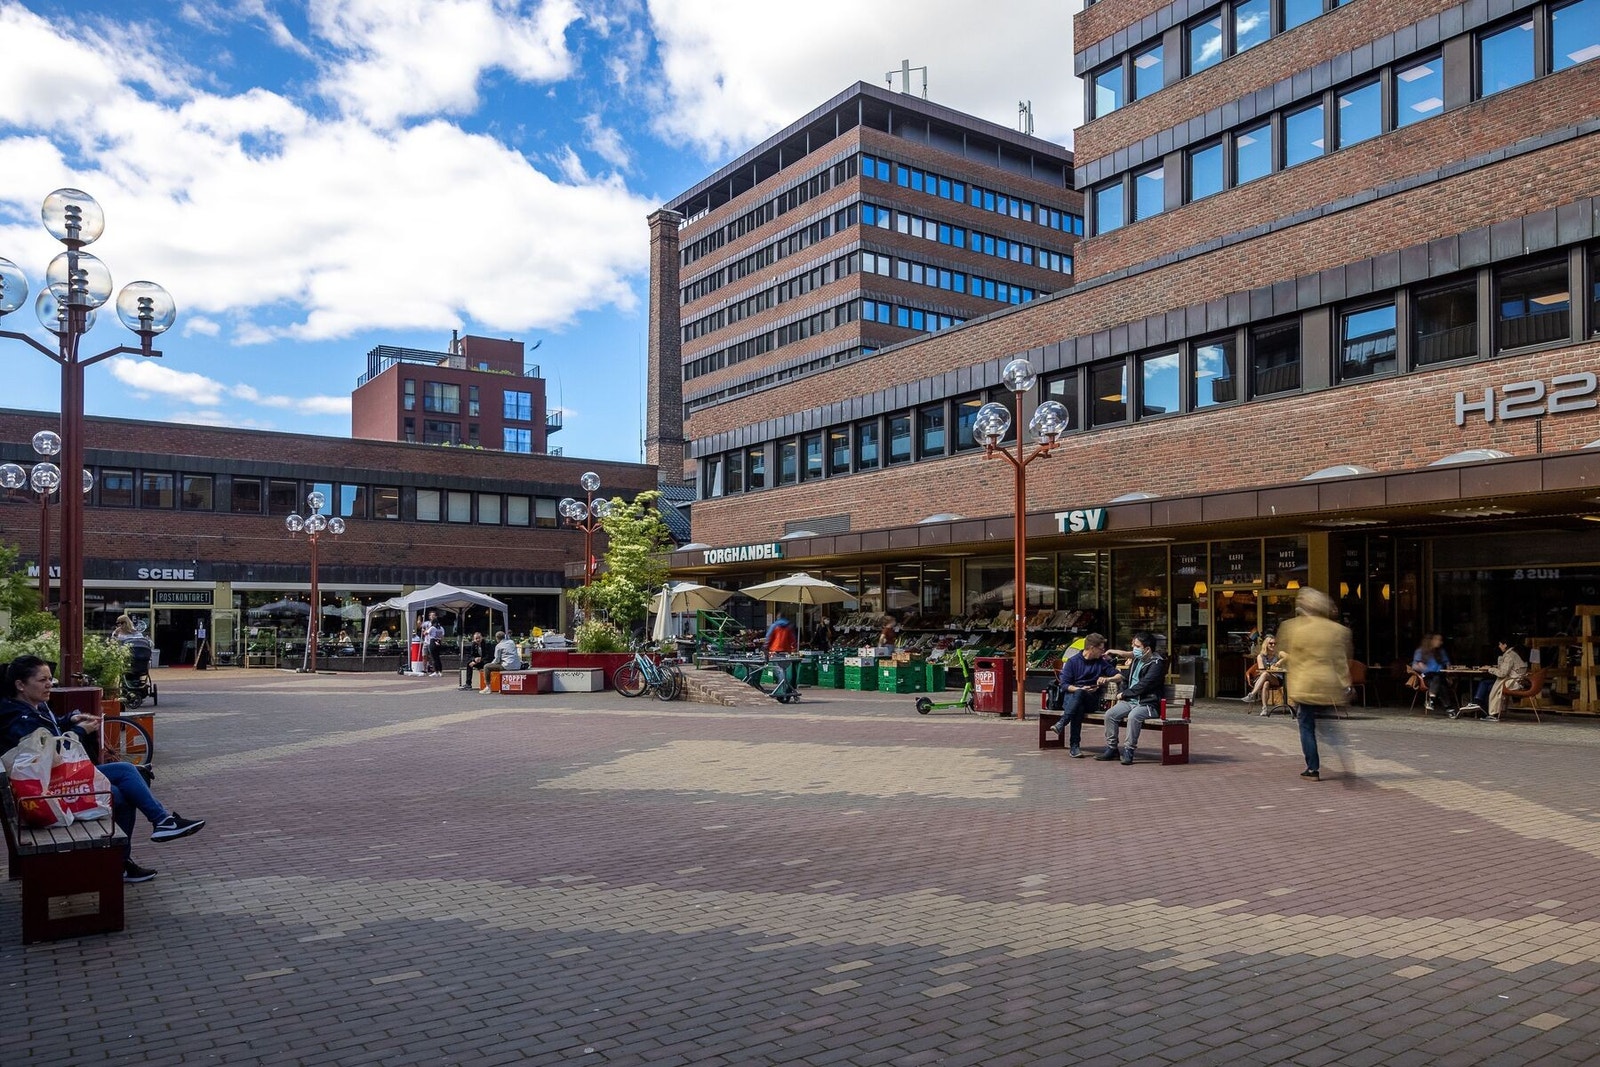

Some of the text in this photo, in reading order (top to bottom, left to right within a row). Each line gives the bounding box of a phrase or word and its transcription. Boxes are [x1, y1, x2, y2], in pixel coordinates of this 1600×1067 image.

[1455, 371, 1598, 426] H22
[1054, 508, 1103, 533] TSV
[703, 543, 780, 565] TORGHANDEL
[137, 567, 195, 580] SCENE
[1231, 563, 1242, 571] BAR
[1278, 561, 1296, 569] PLASS
